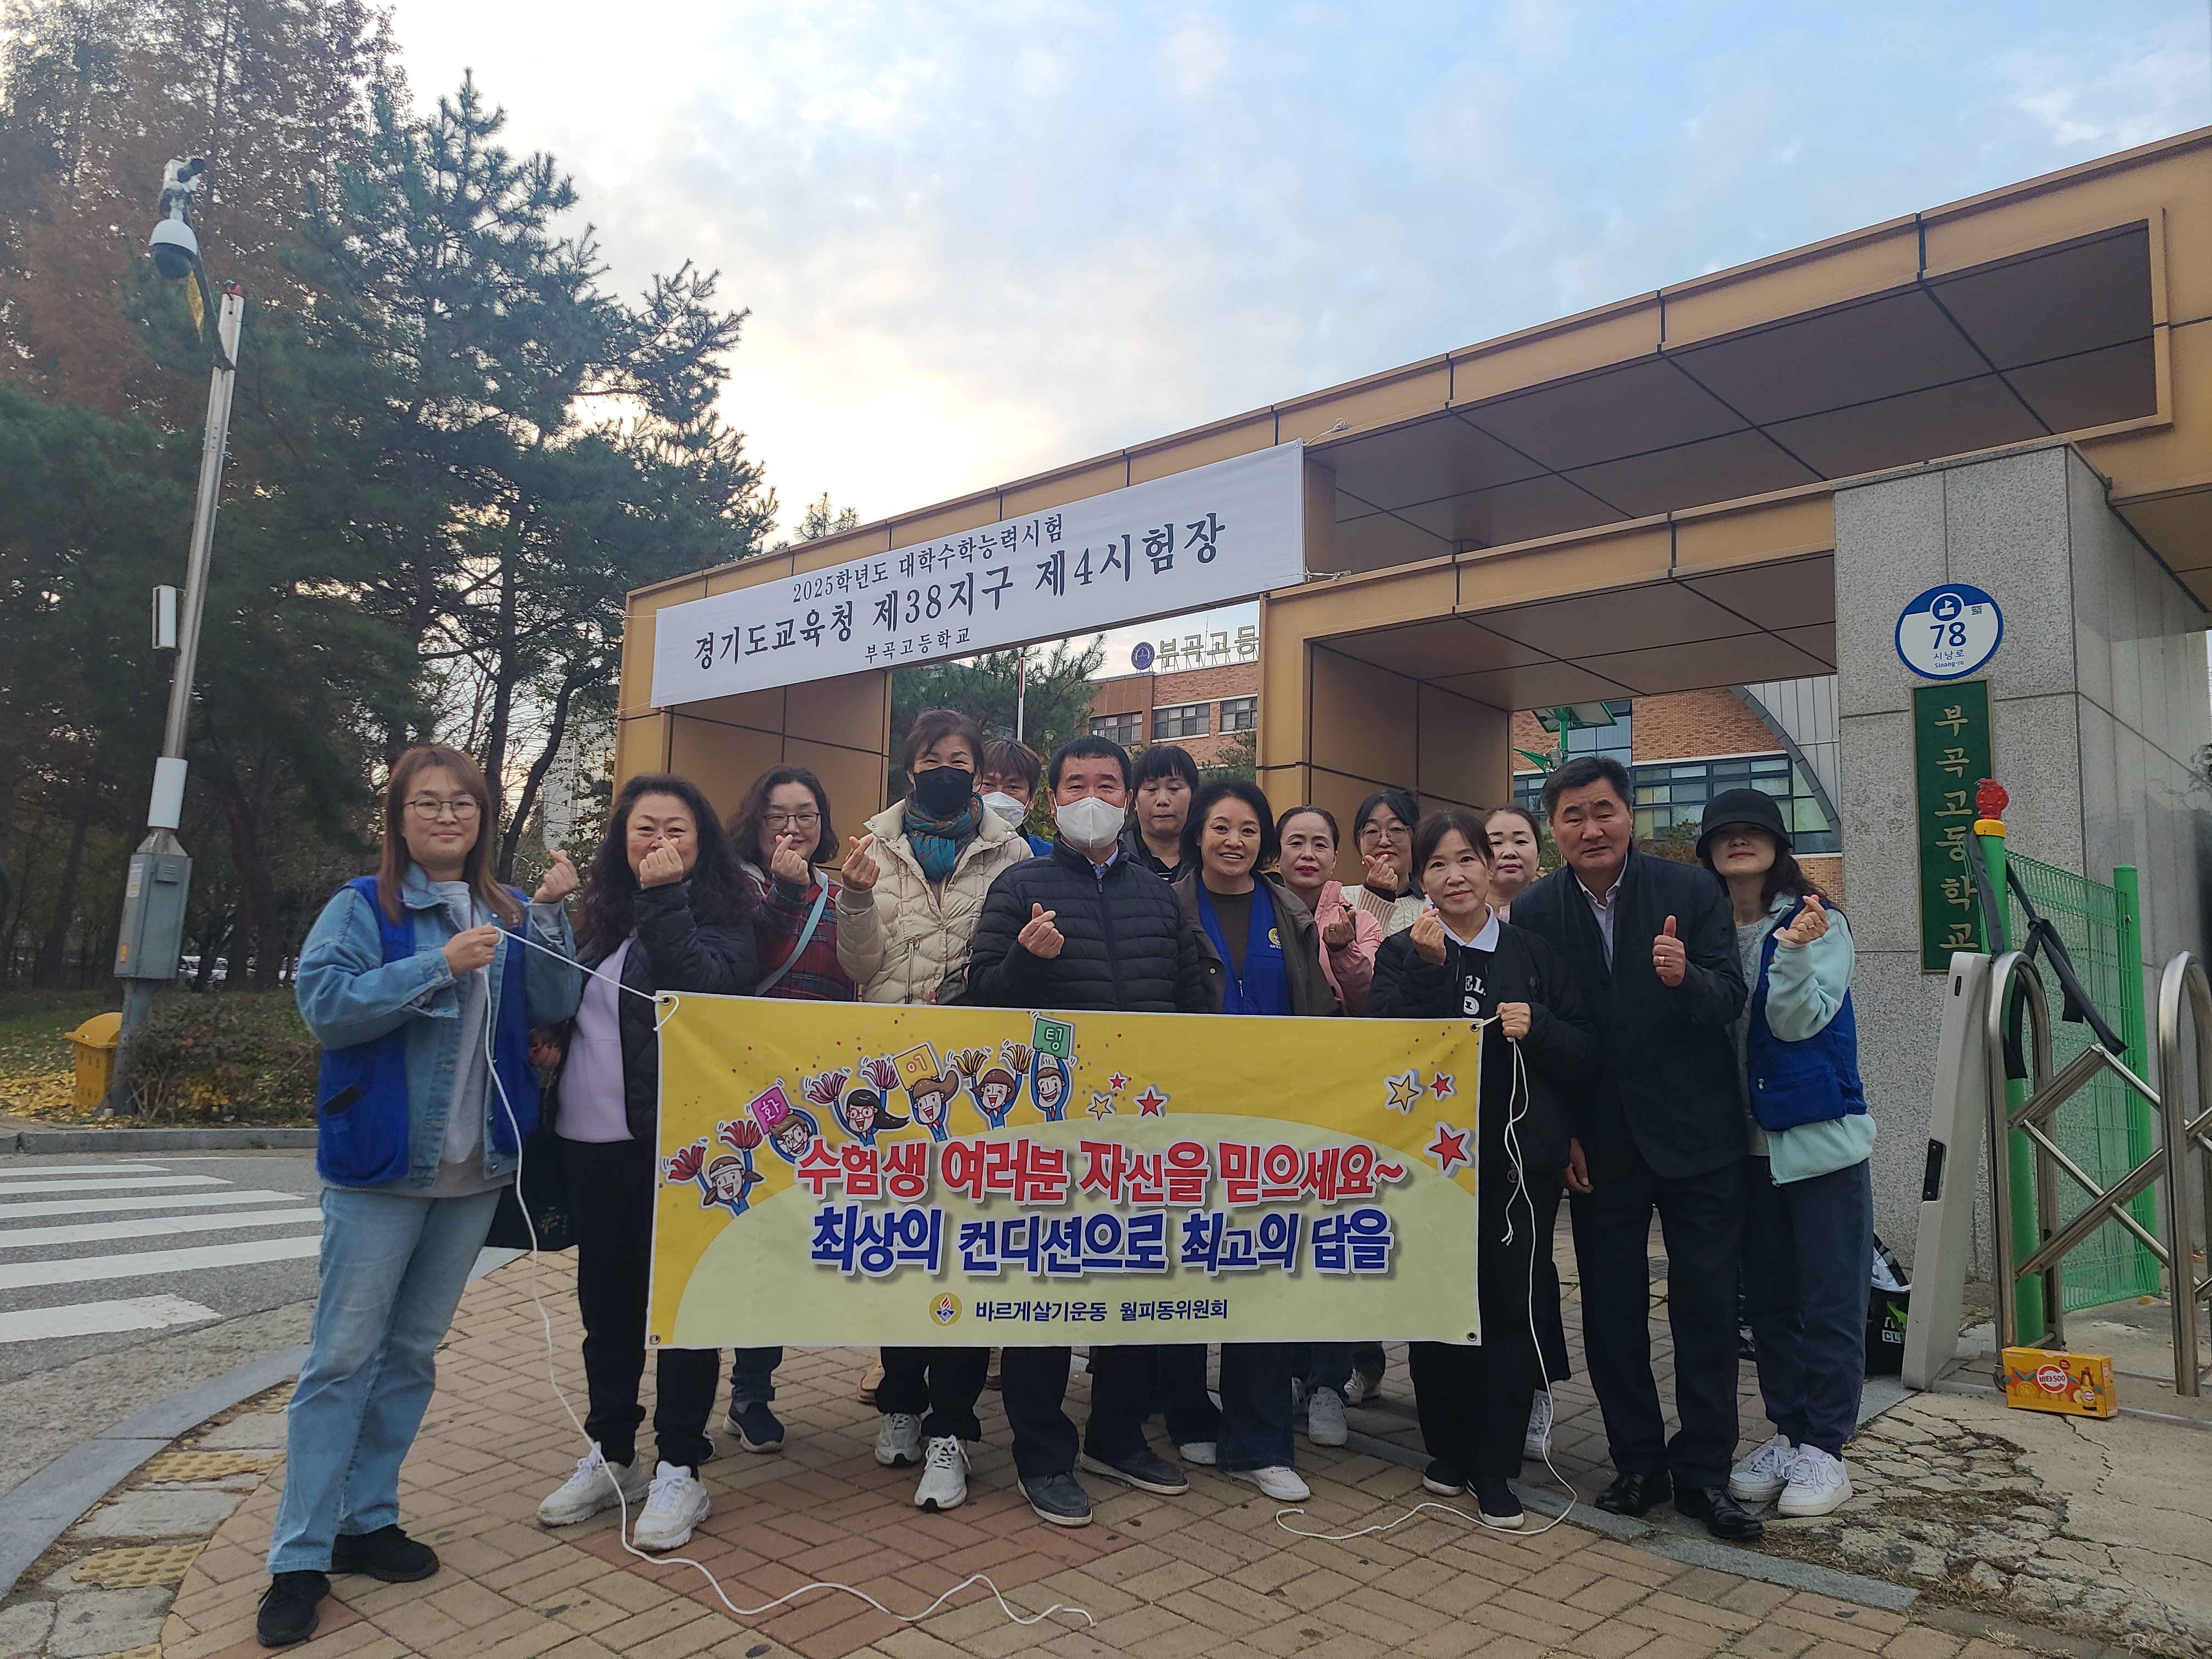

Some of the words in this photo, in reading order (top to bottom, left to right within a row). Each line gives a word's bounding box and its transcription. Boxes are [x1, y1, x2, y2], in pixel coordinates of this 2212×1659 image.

[694, 600, 853, 670] 경기도교육청
[873, 565, 1014, 633] 제38지구
[1035, 512, 1226, 597] 제4시험장
[792, 561, 889, 603] 2025학년도
[899, 513, 1063, 579] 대학수학능력시험
[865, 627, 971, 664] 부곡고등학교
[1929, 621, 1967, 650] 78
[1933, 649, 1965, 661] 시낭로
[1934, 704, 1979, 949] 부곡고등학교
[760, 1097, 782, 1121] 화
[905, 1053, 929, 1074] 이
[1045, 1027, 1064, 1051] 팅
[797, 1138, 929, 1198] 수험생
[940, 1138, 1068, 1201] 여러분
[1079, 1140, 1208, 1203] 자신을
[1218, 1142, 1404, 1203] 믿으세요~
[811, 1204, 943, 1272] 최상의
[957, 1212, 1166, 1273] 컨디션으로
[1181, 1211, 1299, 1272] 최고의
[1311, 1208, 1390, 1269] 답을
[975, 1301, 1108, 1322] 바르게살기운동
[1119, 1299, 1228, 1321] 월피동위원회
